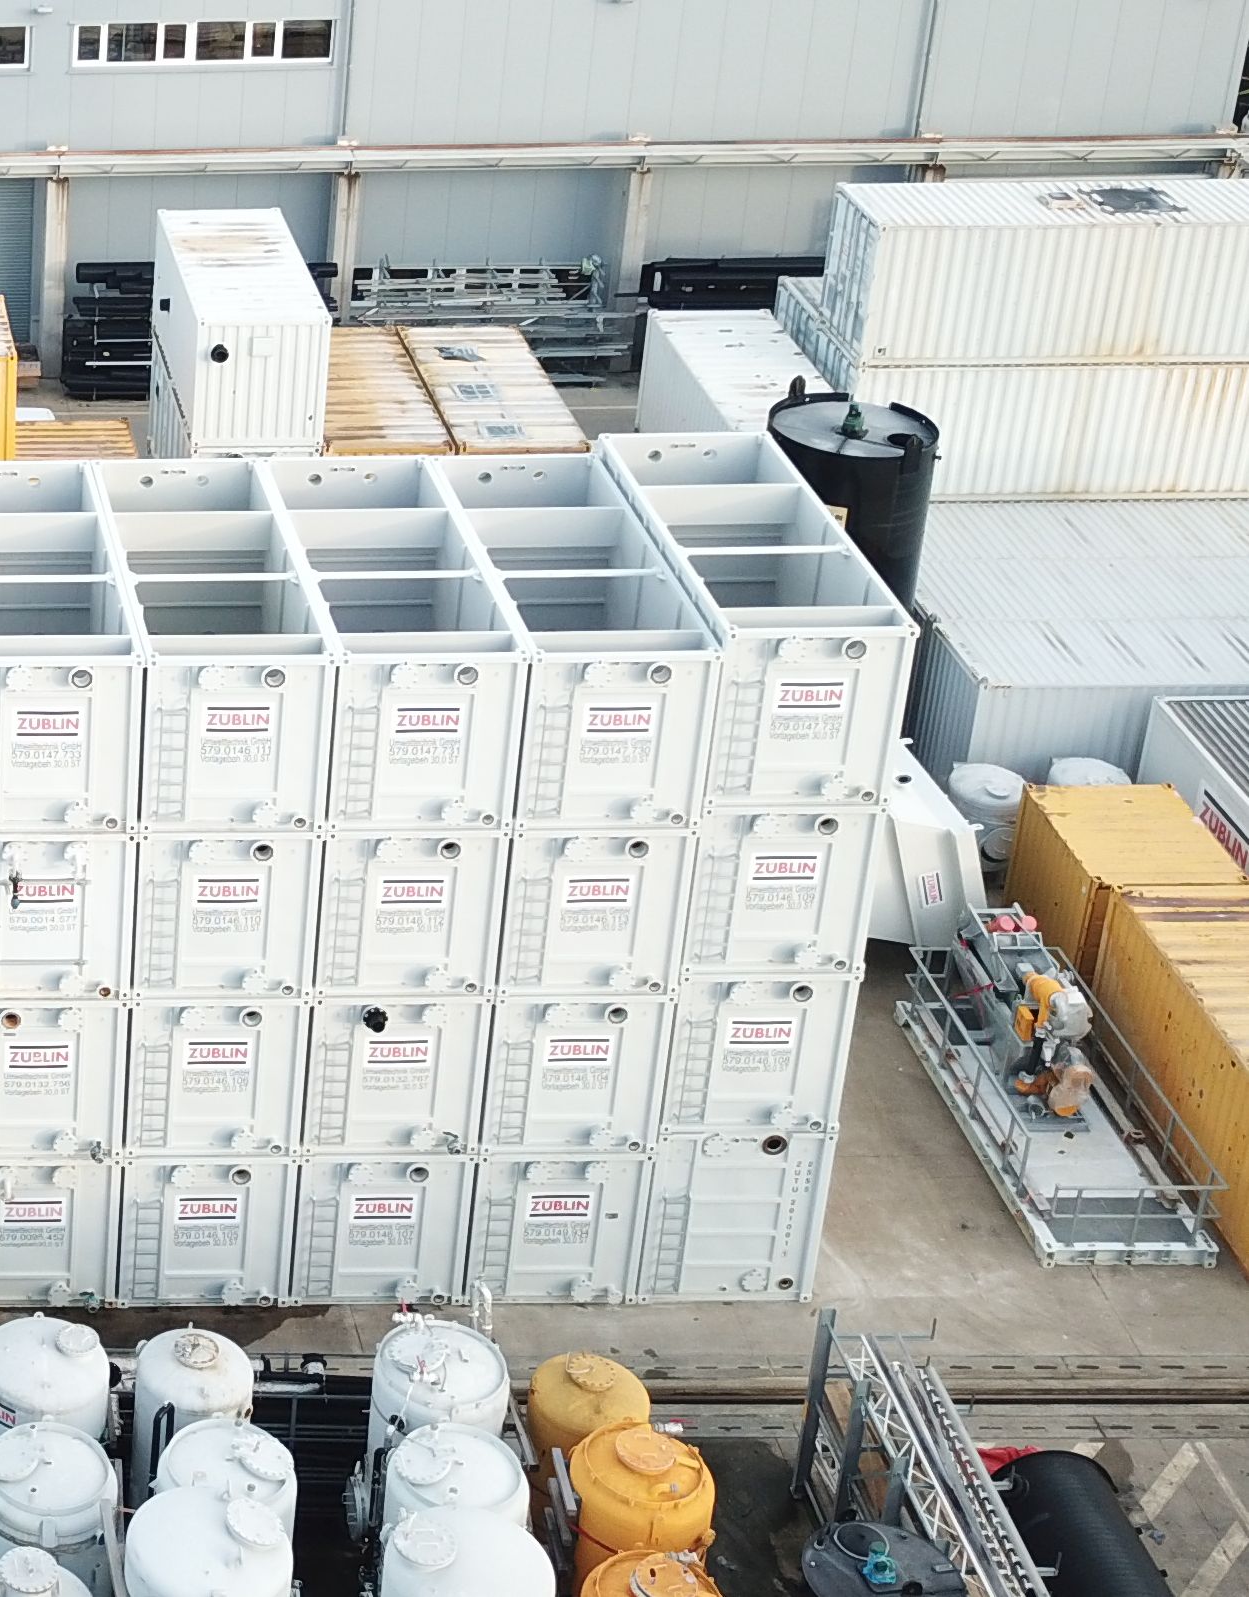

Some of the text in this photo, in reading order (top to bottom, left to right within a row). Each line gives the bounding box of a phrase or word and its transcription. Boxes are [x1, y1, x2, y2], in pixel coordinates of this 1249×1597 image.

[779, 690, 843, 701] ZÜBLIN
[17, 718, 79, 729] ZÜBLIN
[207, 714, 270, 725] ZÜBLIN
[397, 714, 459, 726] ZÜBLIN
[588, 714, 651, 725] ZÜBLIN
[754, 862, 816, 873] ZÜBLIN
[198, 885, 259, 896] ZÜBLIN
[382, 886, 443, 897] ZÜBLIN
[568, 885, 629, 896] ZÜBLIN
[731, 1027, 792, 1037] ZÜBLIN
[188, 1048, 247, 1058] ZÜBLIN
[369, 1046, 428, 1057] ZÜBLIN
[549, 1044, 609, 1055] ZÜBLIN
[10, 1052, 68, 1062] ZÜBLIN
[179, 1203, 237, 1214] ZÜBLIN
[355, 1203, 413, 1213] ZÜBLIN
[531, 1200, 589, 1211] ZÜBLIN
[5, 1207, 62, 1216] ZÜBLIN
